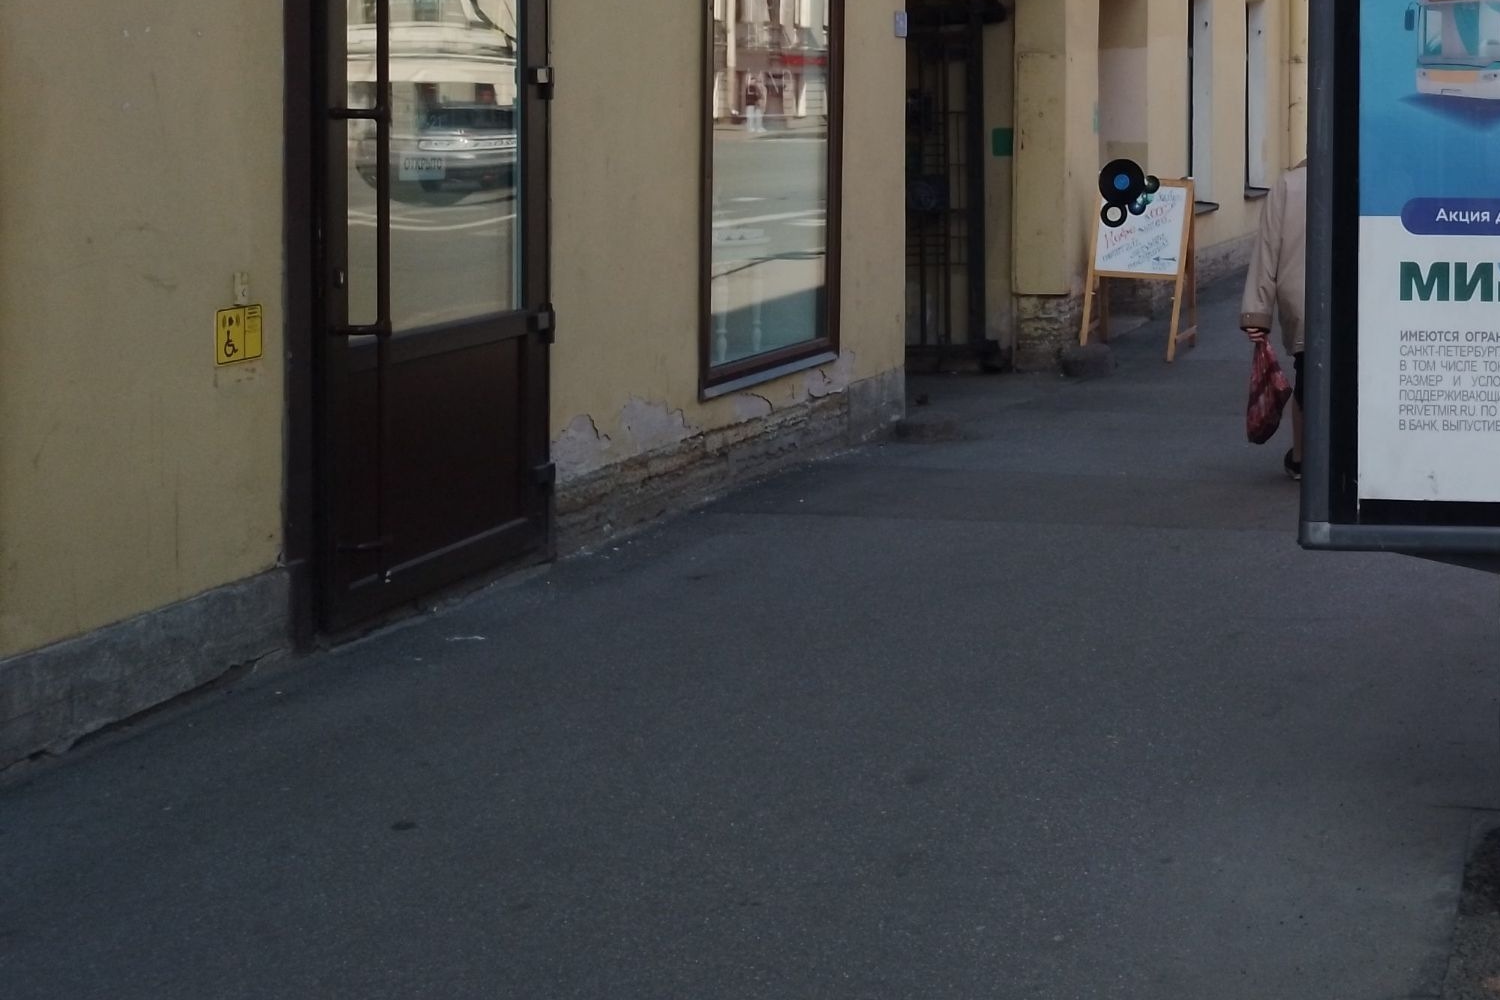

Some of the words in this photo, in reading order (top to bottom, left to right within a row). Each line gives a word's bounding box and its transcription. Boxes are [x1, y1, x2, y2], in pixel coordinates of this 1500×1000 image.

[1436, 208, 1491, 224] Акция
[1400, 330, 1460, 343] ИМЕЮТСЯ
[1400, 360, 1407, 372] В
[1413, 360, 1436, 372] ТОМ
[1440, 360, 1477, 372] ЧИСЛЕ
[1399, 375, 1443, 387] РАЗМЕР
[1453, 375, 1461, 387] И
[1480, 405, 1497, 417] ПО
[1398, 419, 1406, 431] В
